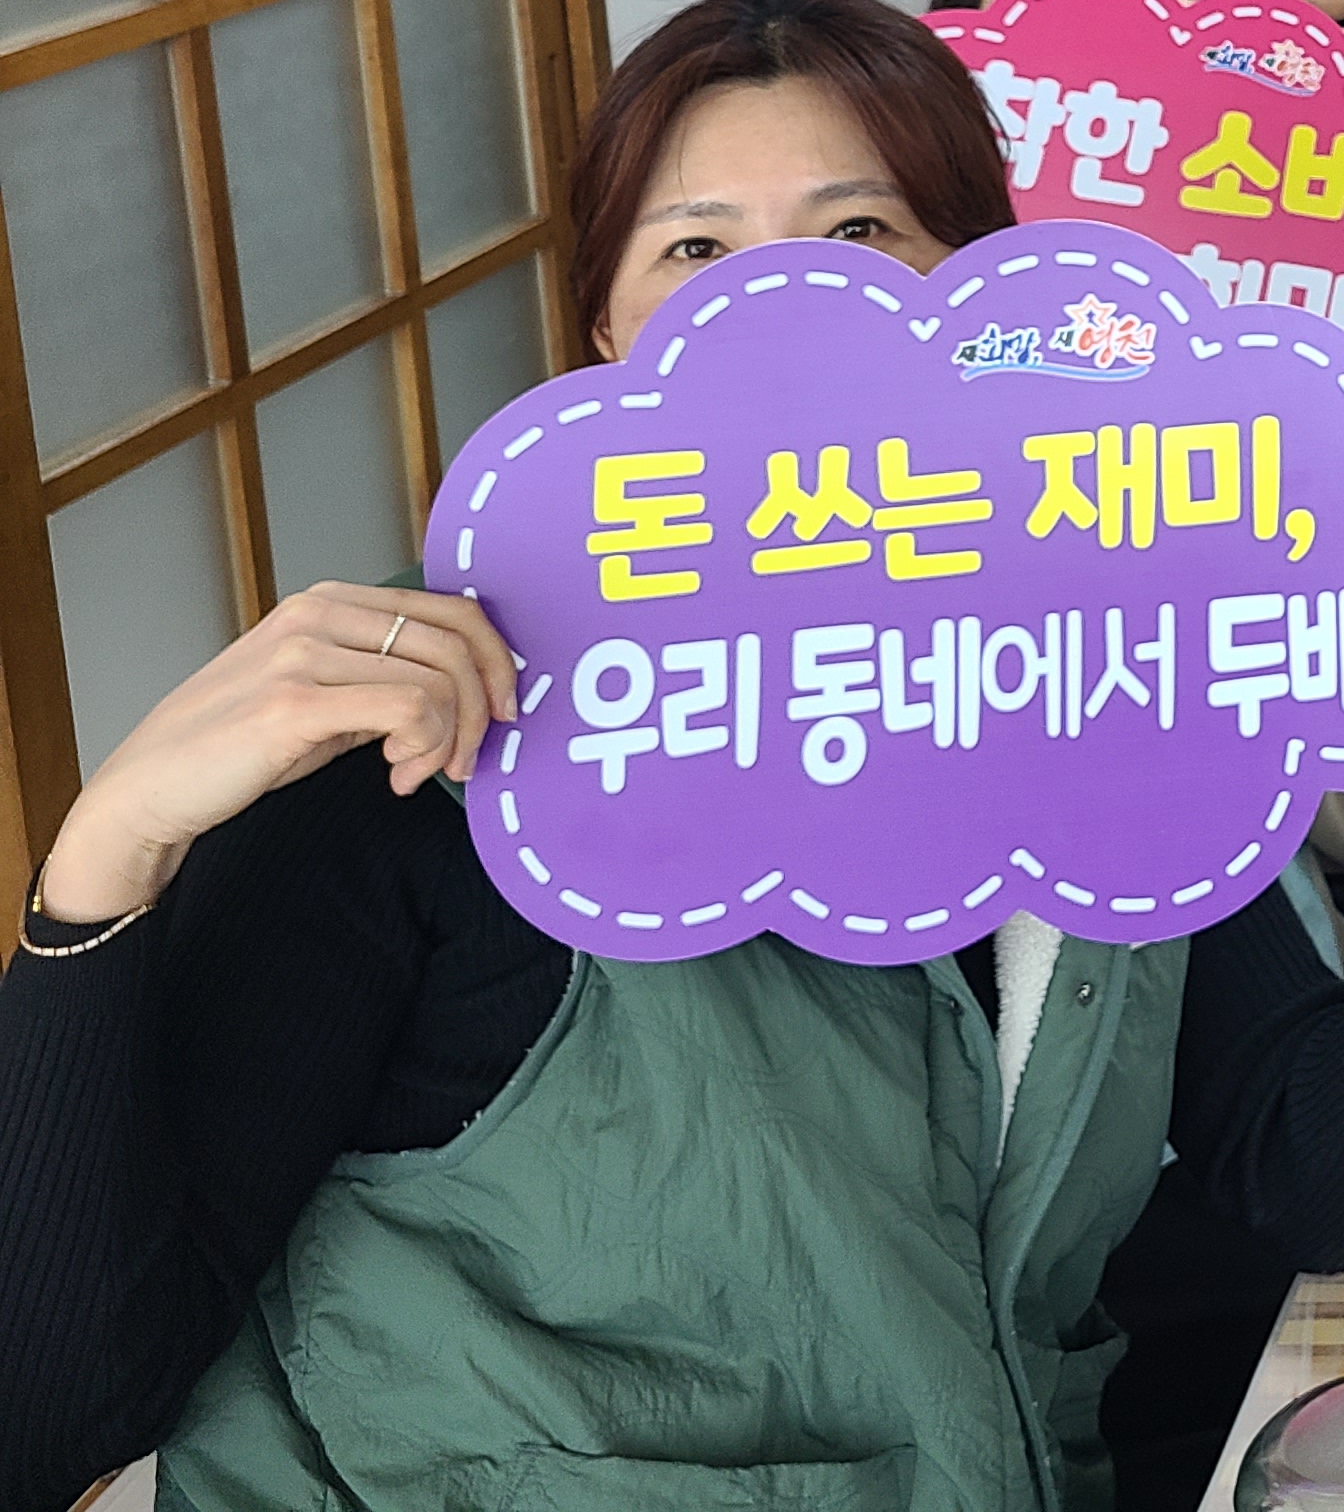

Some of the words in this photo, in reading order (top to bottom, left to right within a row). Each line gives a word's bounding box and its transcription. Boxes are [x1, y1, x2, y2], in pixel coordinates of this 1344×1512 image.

[585, 449, 714, 603] 돈
[746, 436, 995, 581] 쓰는
[1022, 414, 1317, 562] 재미,
[567, 631, 762, 795] 우리
[787, 602, 1177, 787] 동네에서
